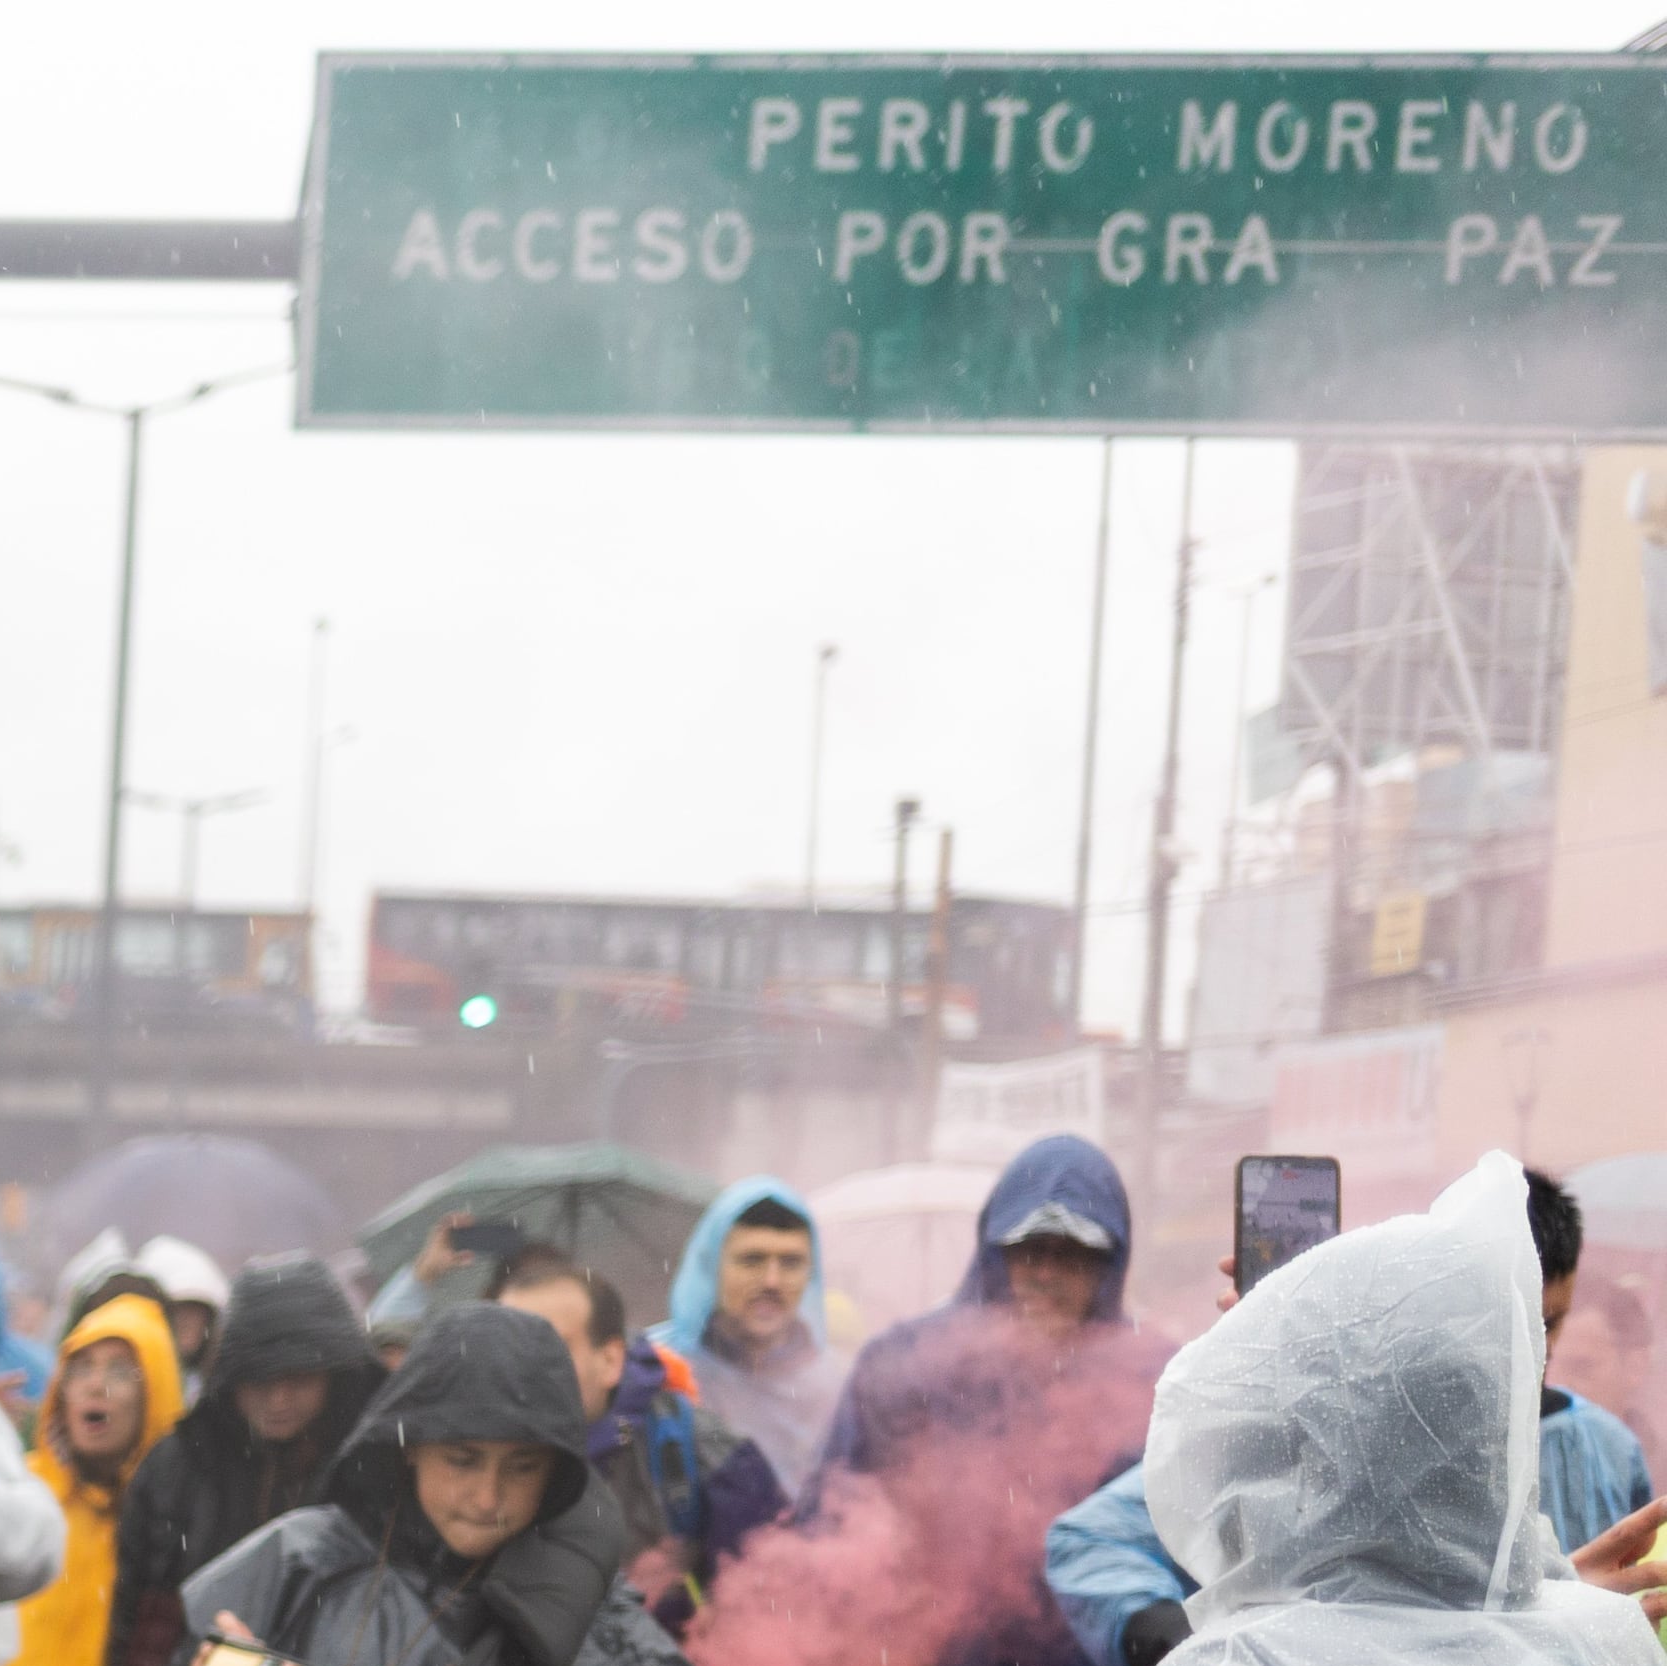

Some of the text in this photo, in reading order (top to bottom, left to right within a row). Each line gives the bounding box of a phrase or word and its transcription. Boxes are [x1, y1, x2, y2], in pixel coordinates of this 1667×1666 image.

[747, 97, 1590, 174] PERITO MORENO
[392, 208, 1624, 285] ACCESO POR GRA PAZ
